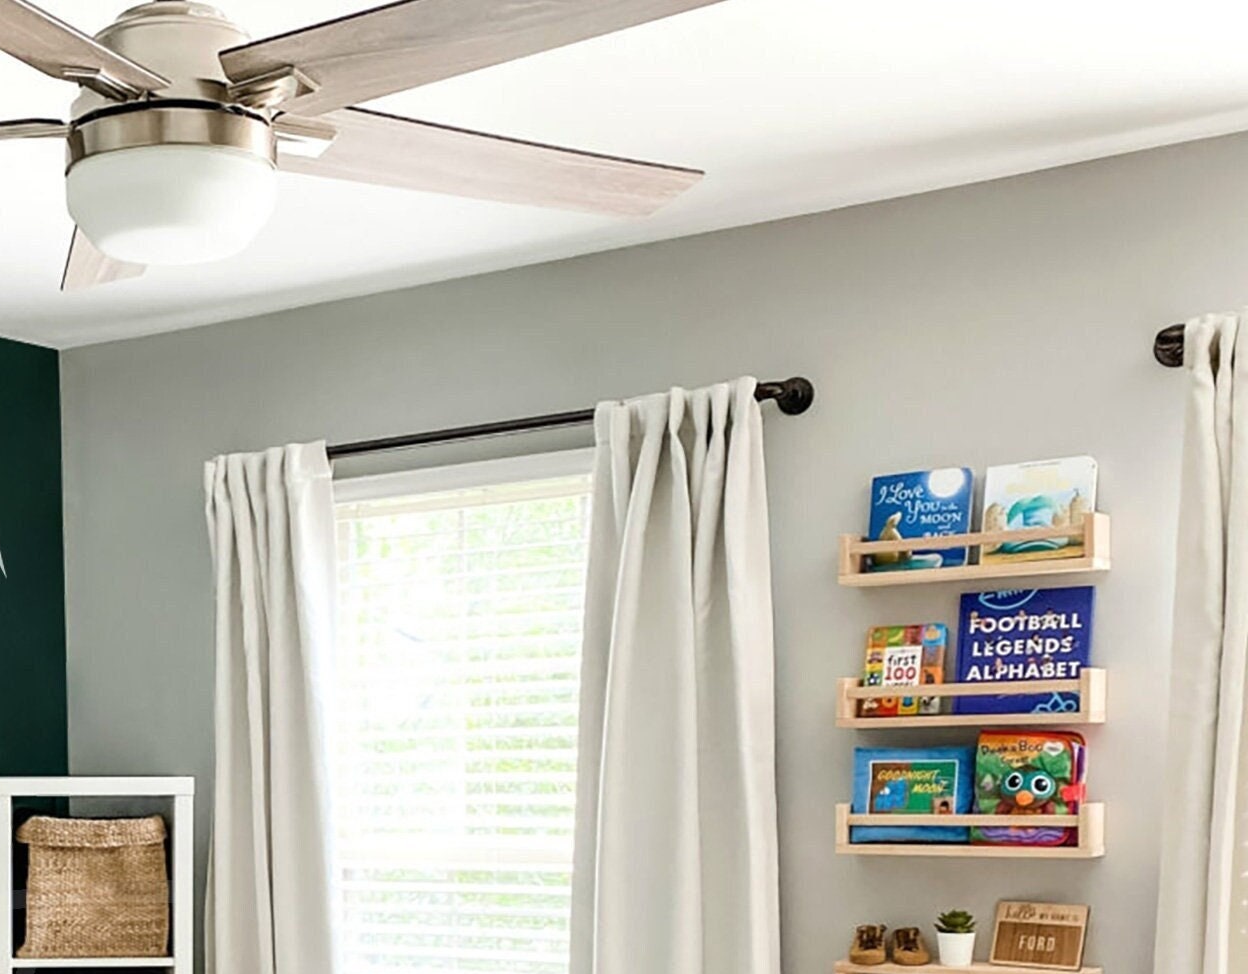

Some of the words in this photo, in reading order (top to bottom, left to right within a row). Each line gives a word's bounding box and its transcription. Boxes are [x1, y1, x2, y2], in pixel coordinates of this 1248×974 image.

[969, 613, 1083, 634] FOOTBALL
[972, 635, 1075, 657] LEGENDS
[884, 665, 917, 681] 100
[966, 660, 1081, 681] ALPHABET
[1018, 934, 1056, 952] FORD
